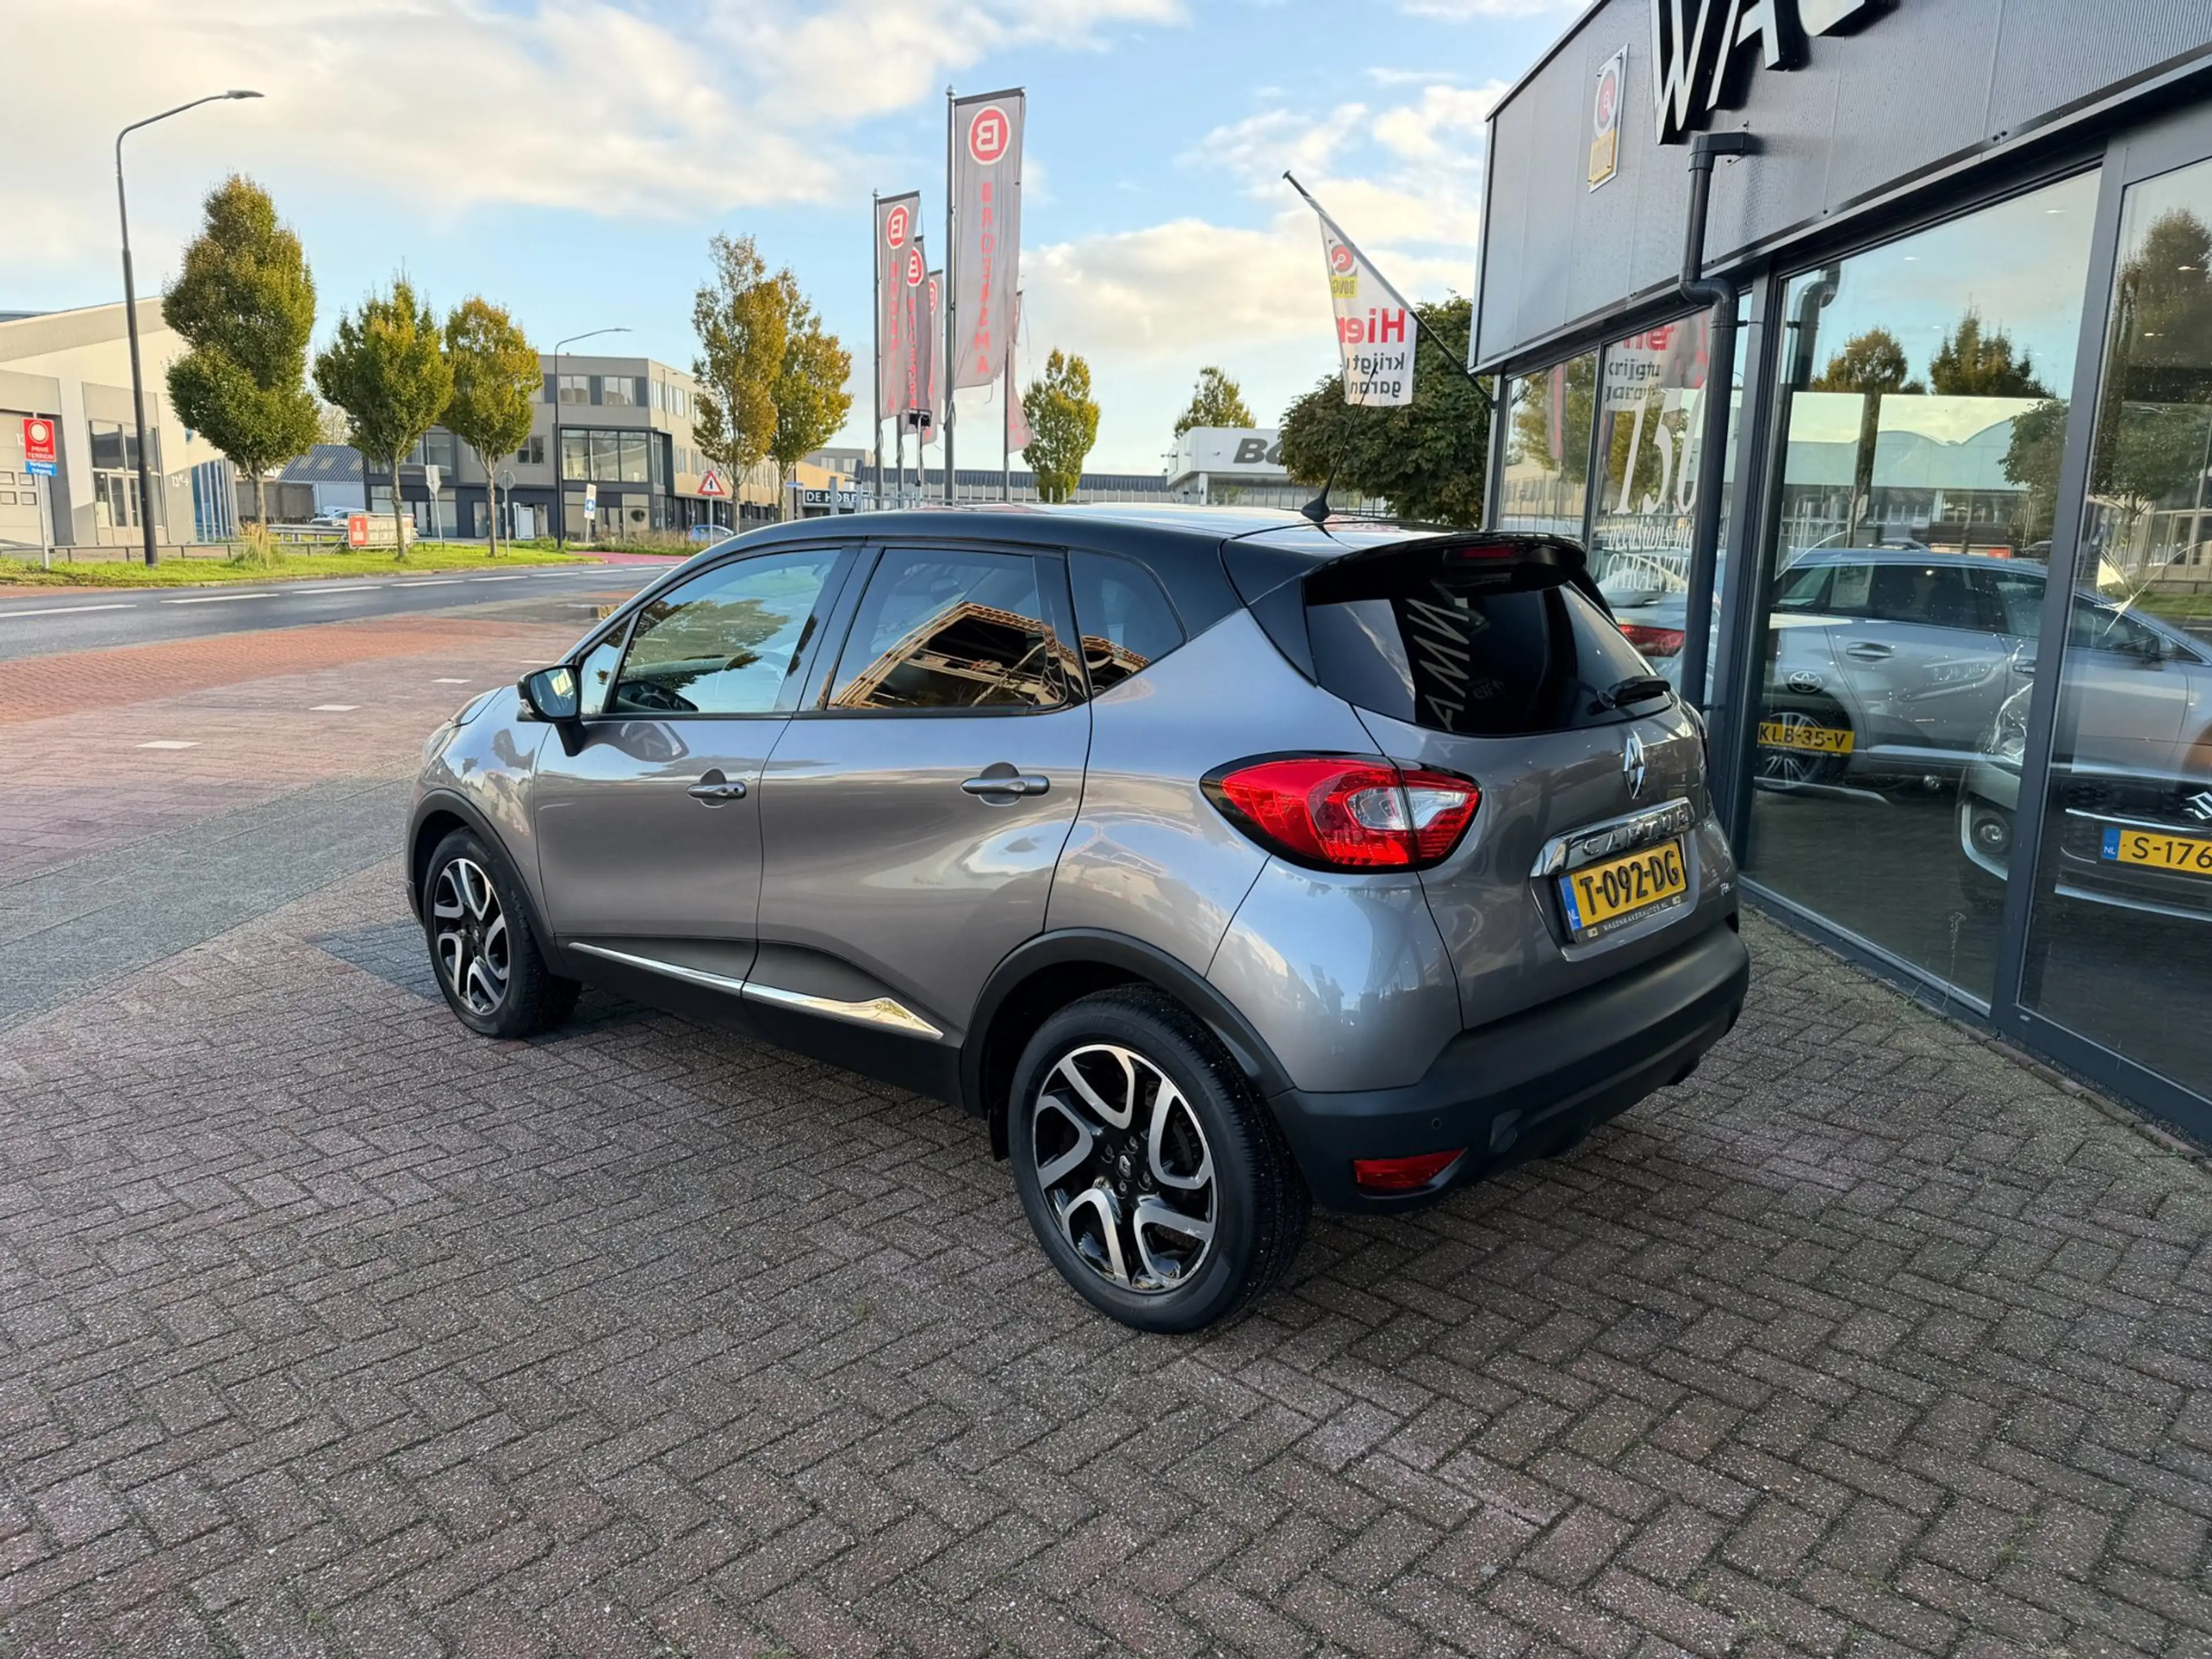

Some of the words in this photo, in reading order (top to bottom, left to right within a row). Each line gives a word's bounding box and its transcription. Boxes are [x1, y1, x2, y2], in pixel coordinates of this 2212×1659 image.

[1650, 0, 1866, 145] WA
[807, 491, 821, 502] DE
[1759, 725, 1846, 749] KLB-35-V
[2103, 846, 2116, 855] NL
[2131, 836, 2212, 869] S-176
[1578, 850, 1680, 916] T-092-DG
